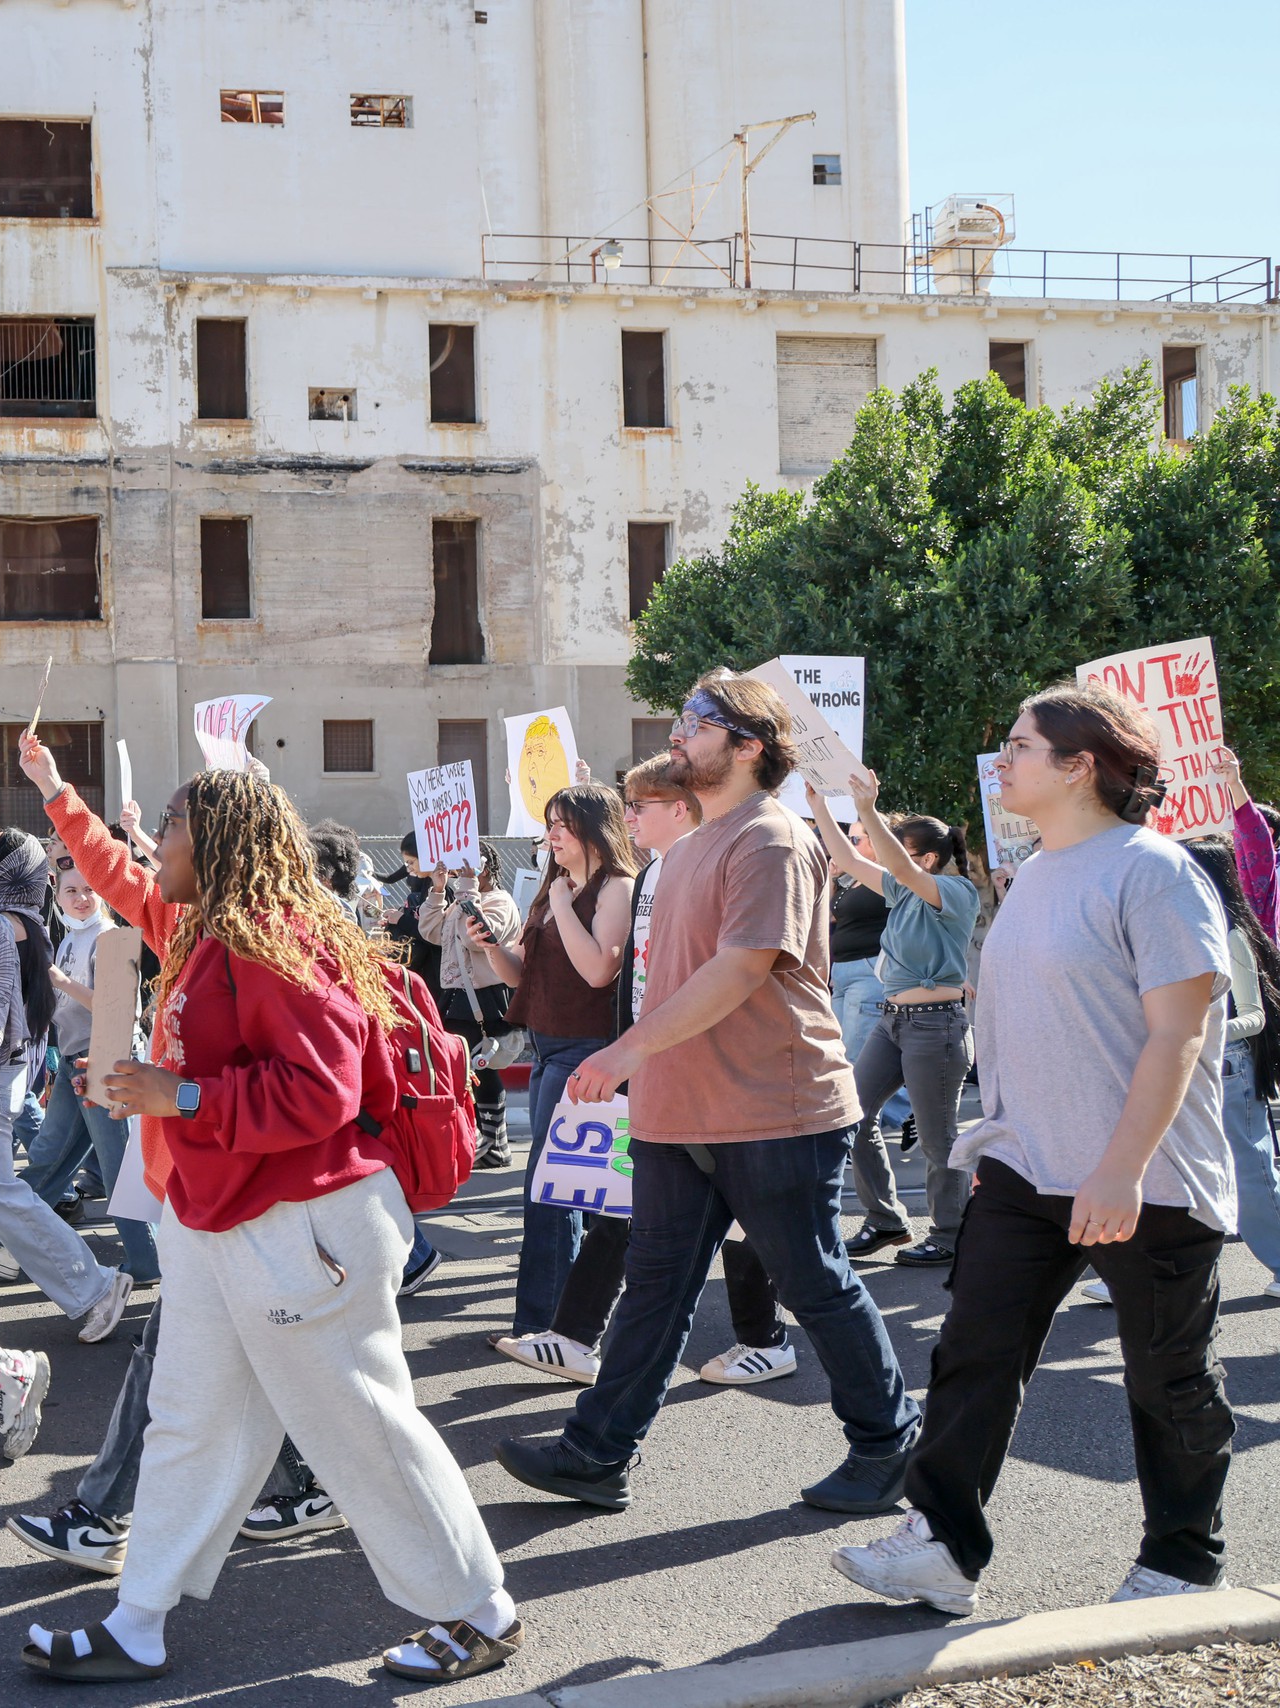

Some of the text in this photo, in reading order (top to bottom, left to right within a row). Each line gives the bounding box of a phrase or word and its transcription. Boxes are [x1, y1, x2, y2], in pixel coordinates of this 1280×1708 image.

[793, 669, 821, 684] THE
[809, 691, 861, 708] WRONG
[1157, 694, 1221, 748] THE
[409, 762, 466, 798] WHERE WERE
[413, 782, 467, 816] YOUR PAPERS IN
